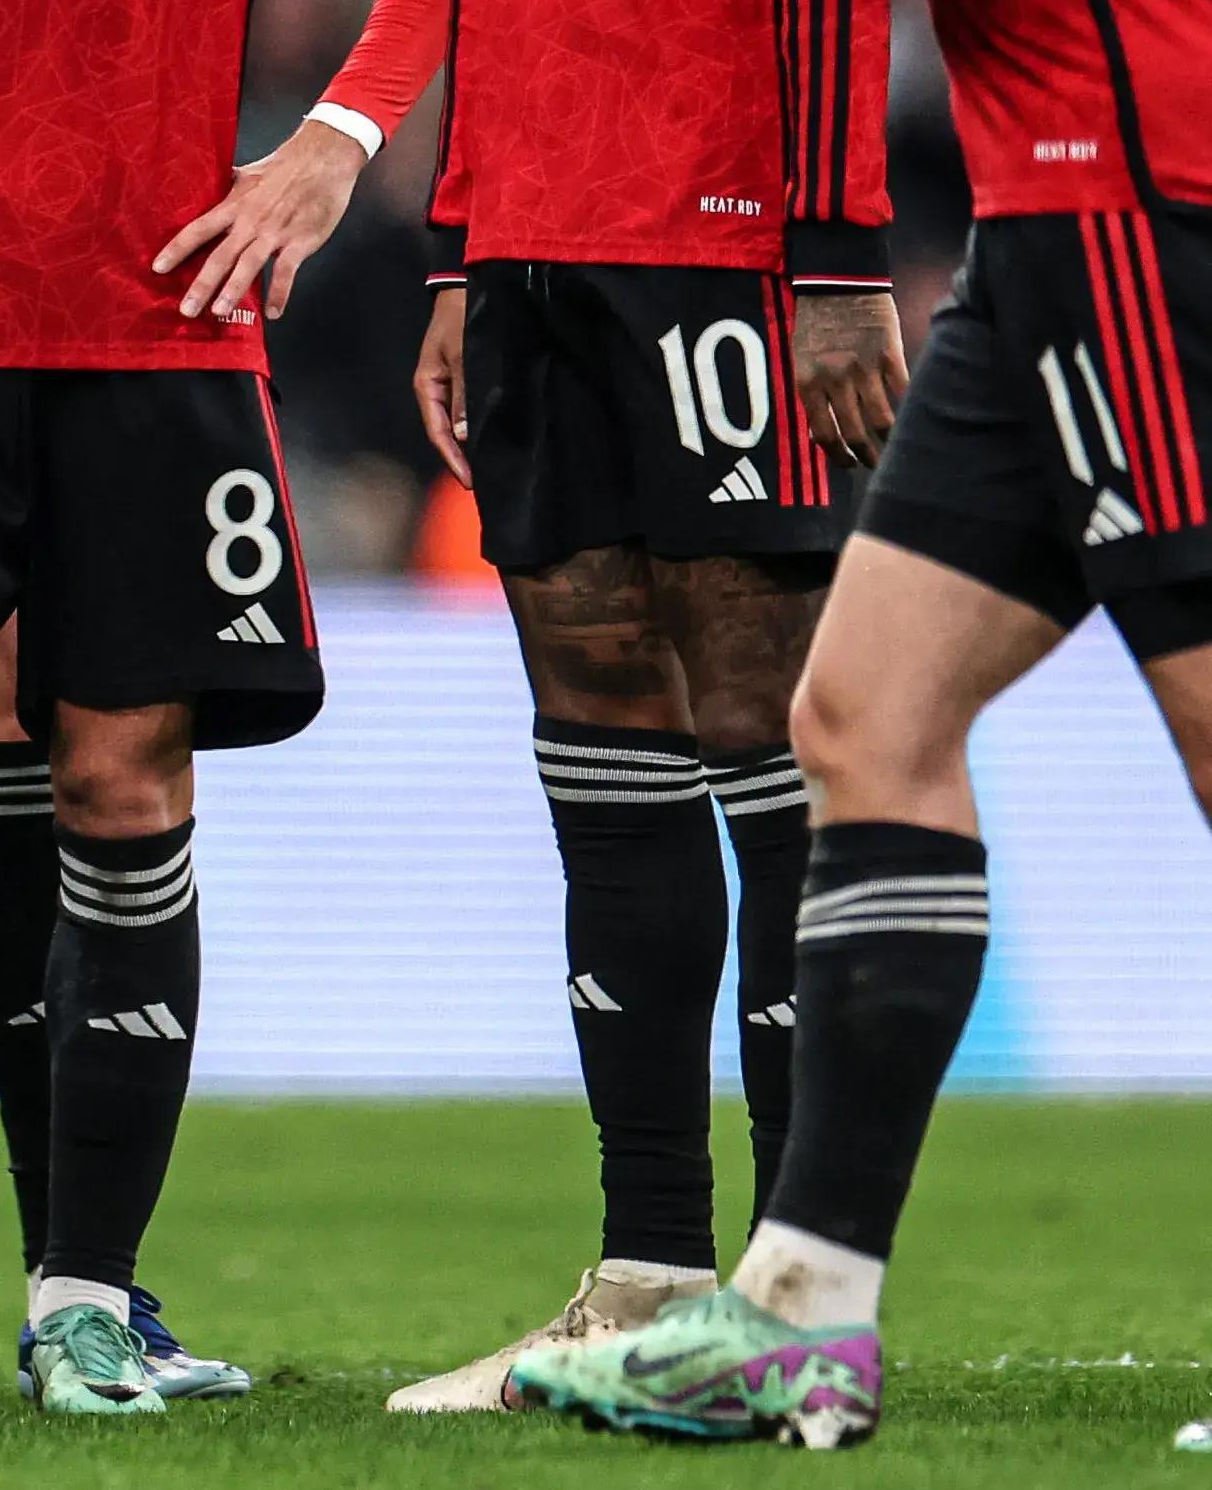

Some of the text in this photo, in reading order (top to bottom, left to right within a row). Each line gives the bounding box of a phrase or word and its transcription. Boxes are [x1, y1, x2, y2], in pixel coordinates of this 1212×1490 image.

[657, 318, 770, 457] 10
[1038, 341, 1128, 486] 11
[205, 467, 284, 596] 8
